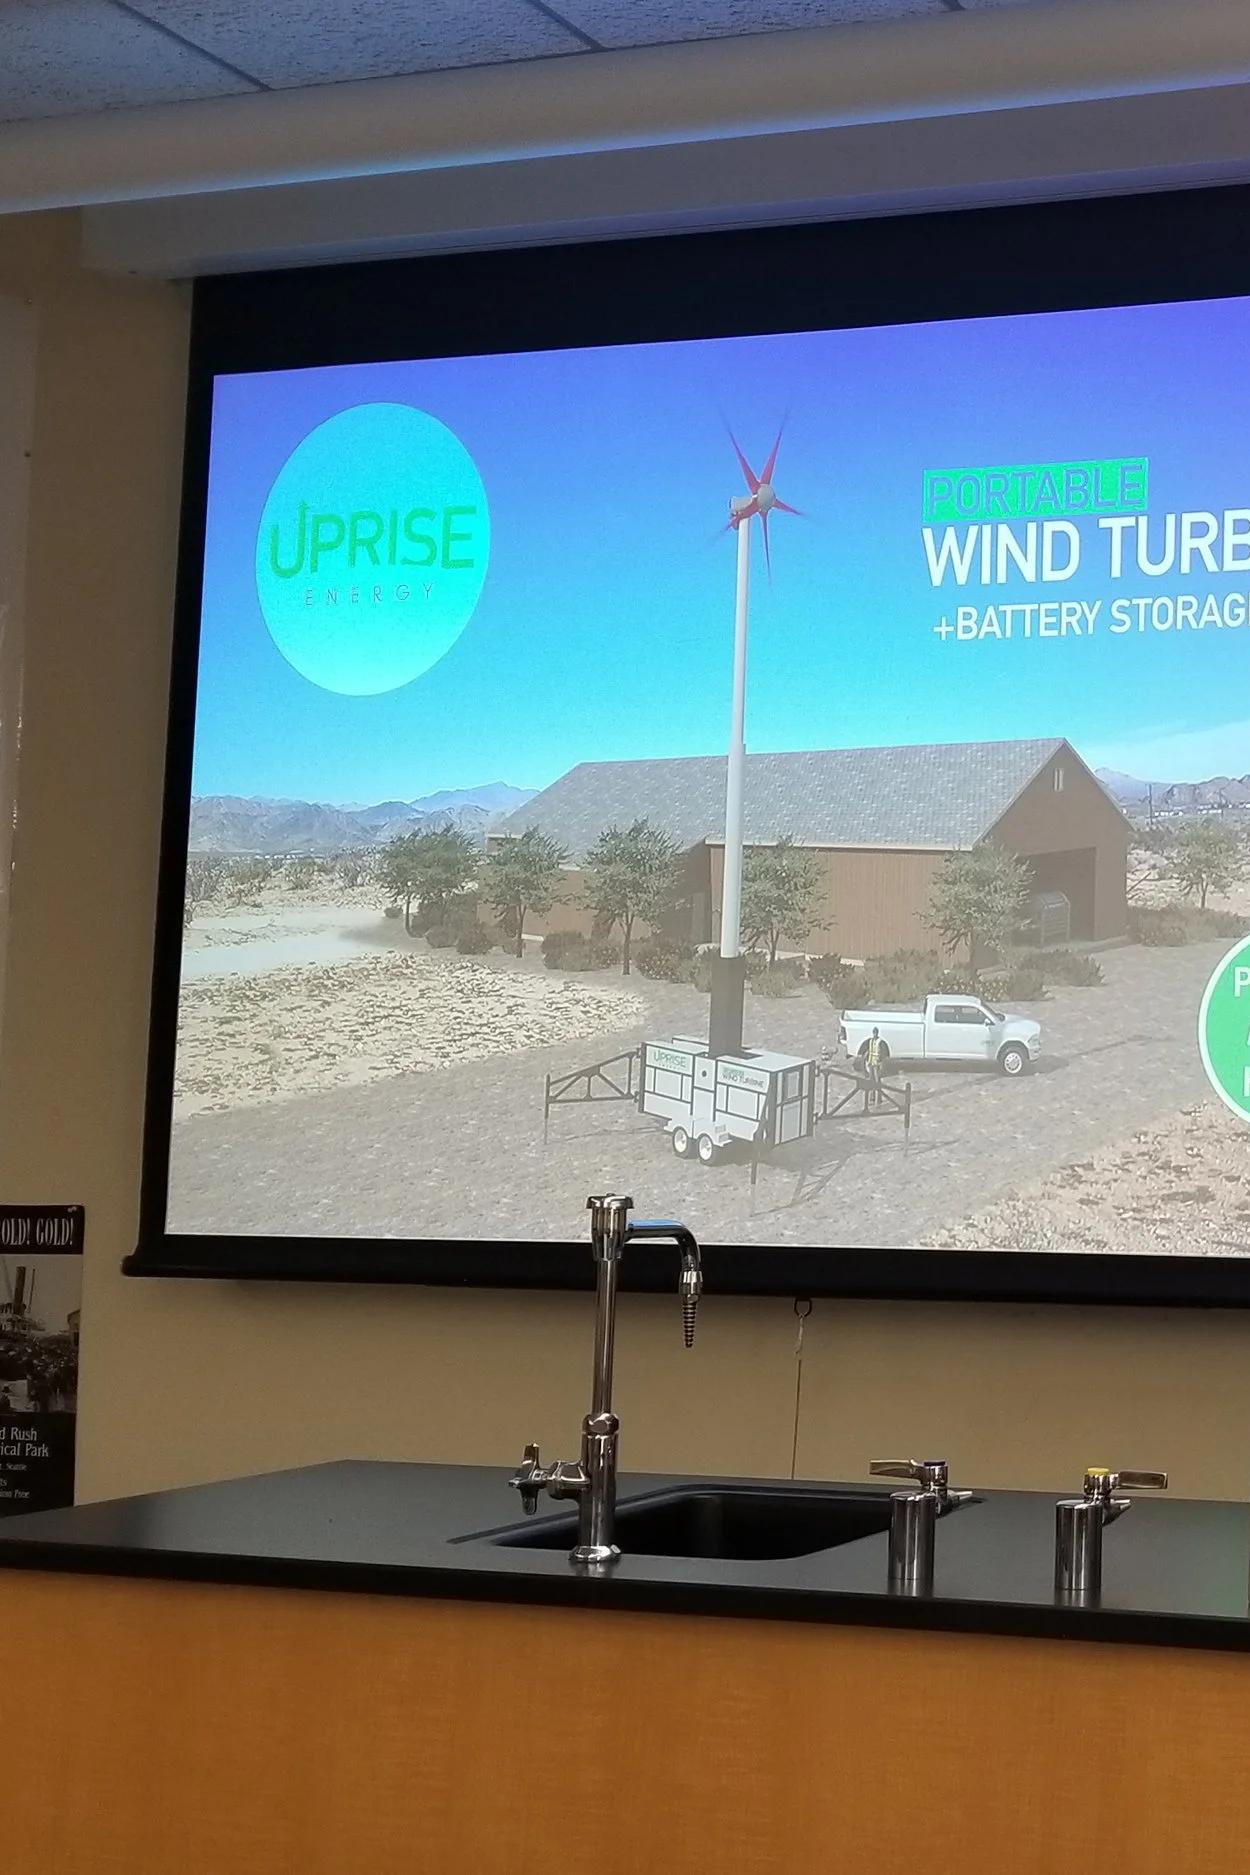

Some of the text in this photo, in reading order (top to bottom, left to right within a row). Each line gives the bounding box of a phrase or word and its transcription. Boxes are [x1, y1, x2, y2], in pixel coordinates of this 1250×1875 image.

[927, 463, 1145, 516] PORTABLE
[269, 501, 477, 579] UPRISE
[921, 520, 1081, 587] WIND
[304, 583, 434, 607] ENERGY
[932, 600, 1102, 642] +BATTERY
[653, 1049, 688, 1069] UPRISE
[1, 1217, 74, 1246] OLD! GOLD!
[10, 1427, 37, 1441] Rush
[25, 1443, 49, 1457] Park
